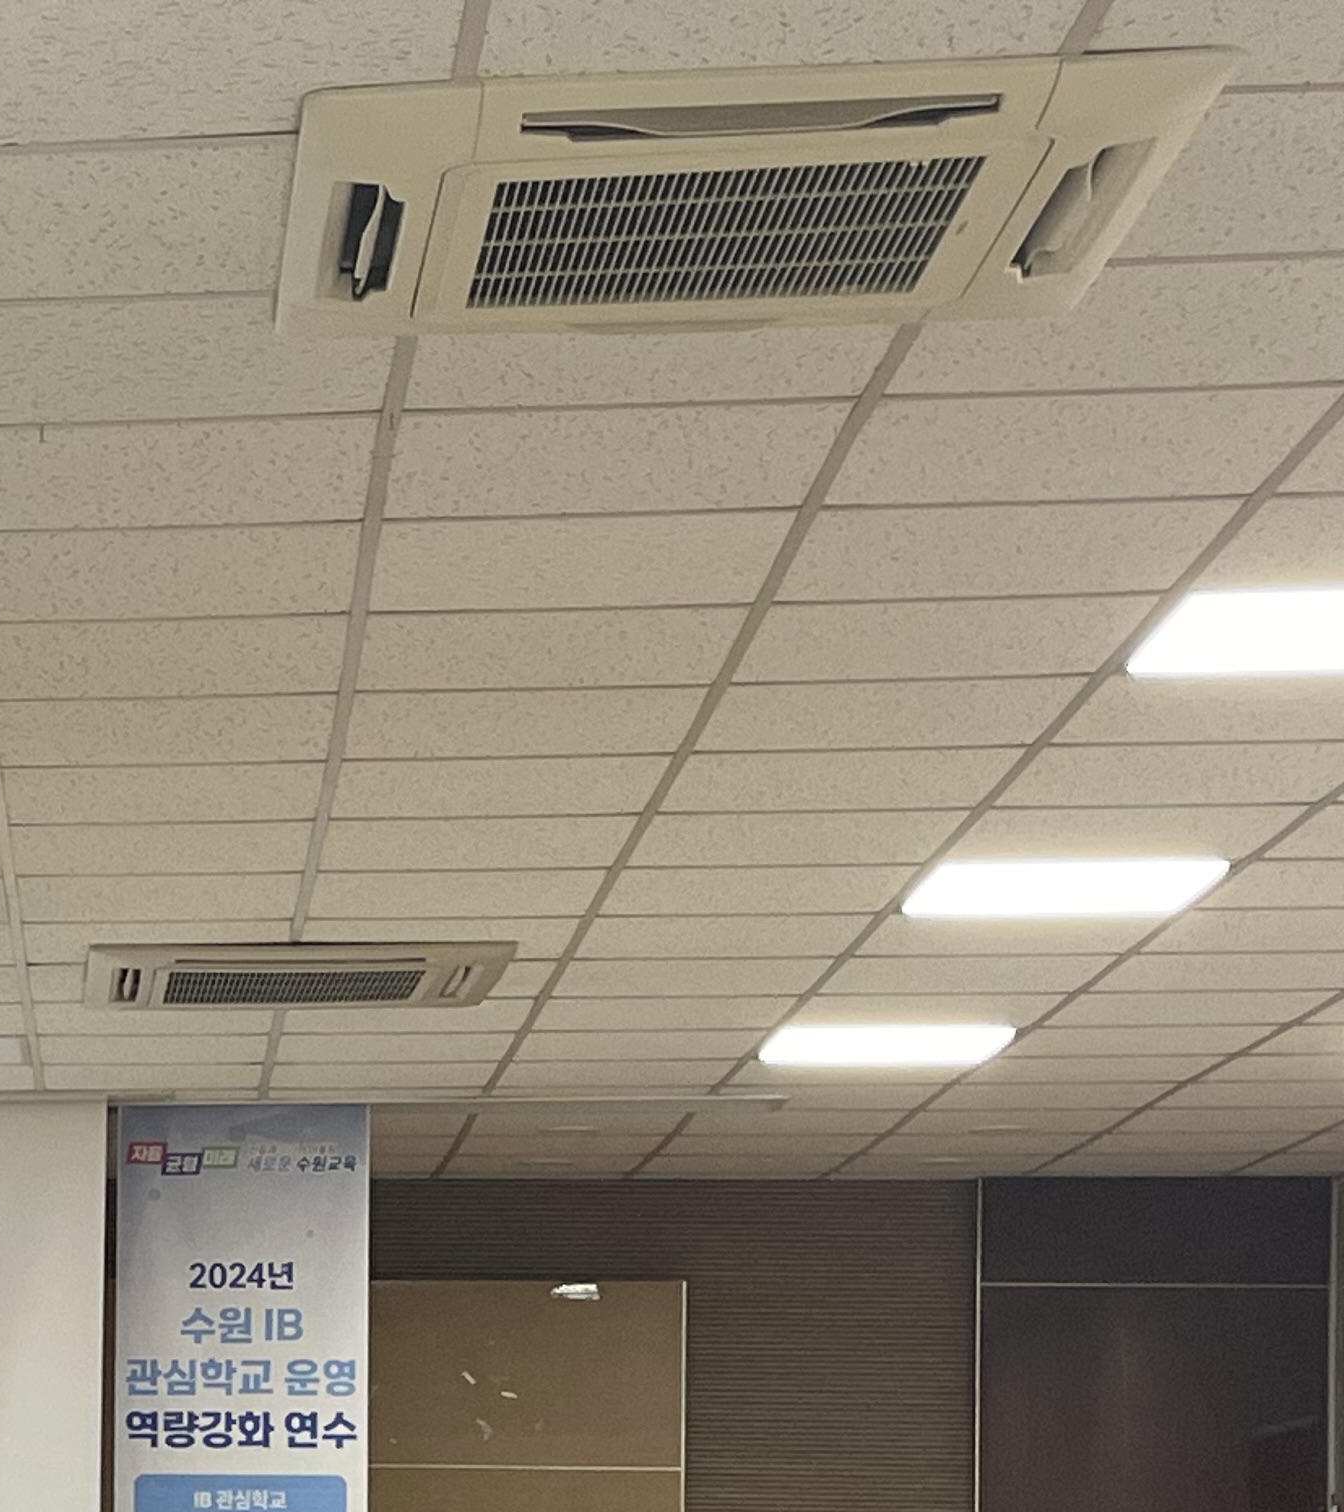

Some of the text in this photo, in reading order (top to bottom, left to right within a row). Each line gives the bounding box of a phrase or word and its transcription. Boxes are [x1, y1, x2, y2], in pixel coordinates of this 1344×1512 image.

[297, 1155, 356, 1173] 수원교육
[189, 1261, 295, 1290] 2024년
[181, 1307, 303, 1344] 수원 IB
[126, 1358, 356, 1397] 관심학교 운영
[126, 1410, 357, 1449] 역량강화 연수
[194, 1489, 287, 1510] IB 관심학교
